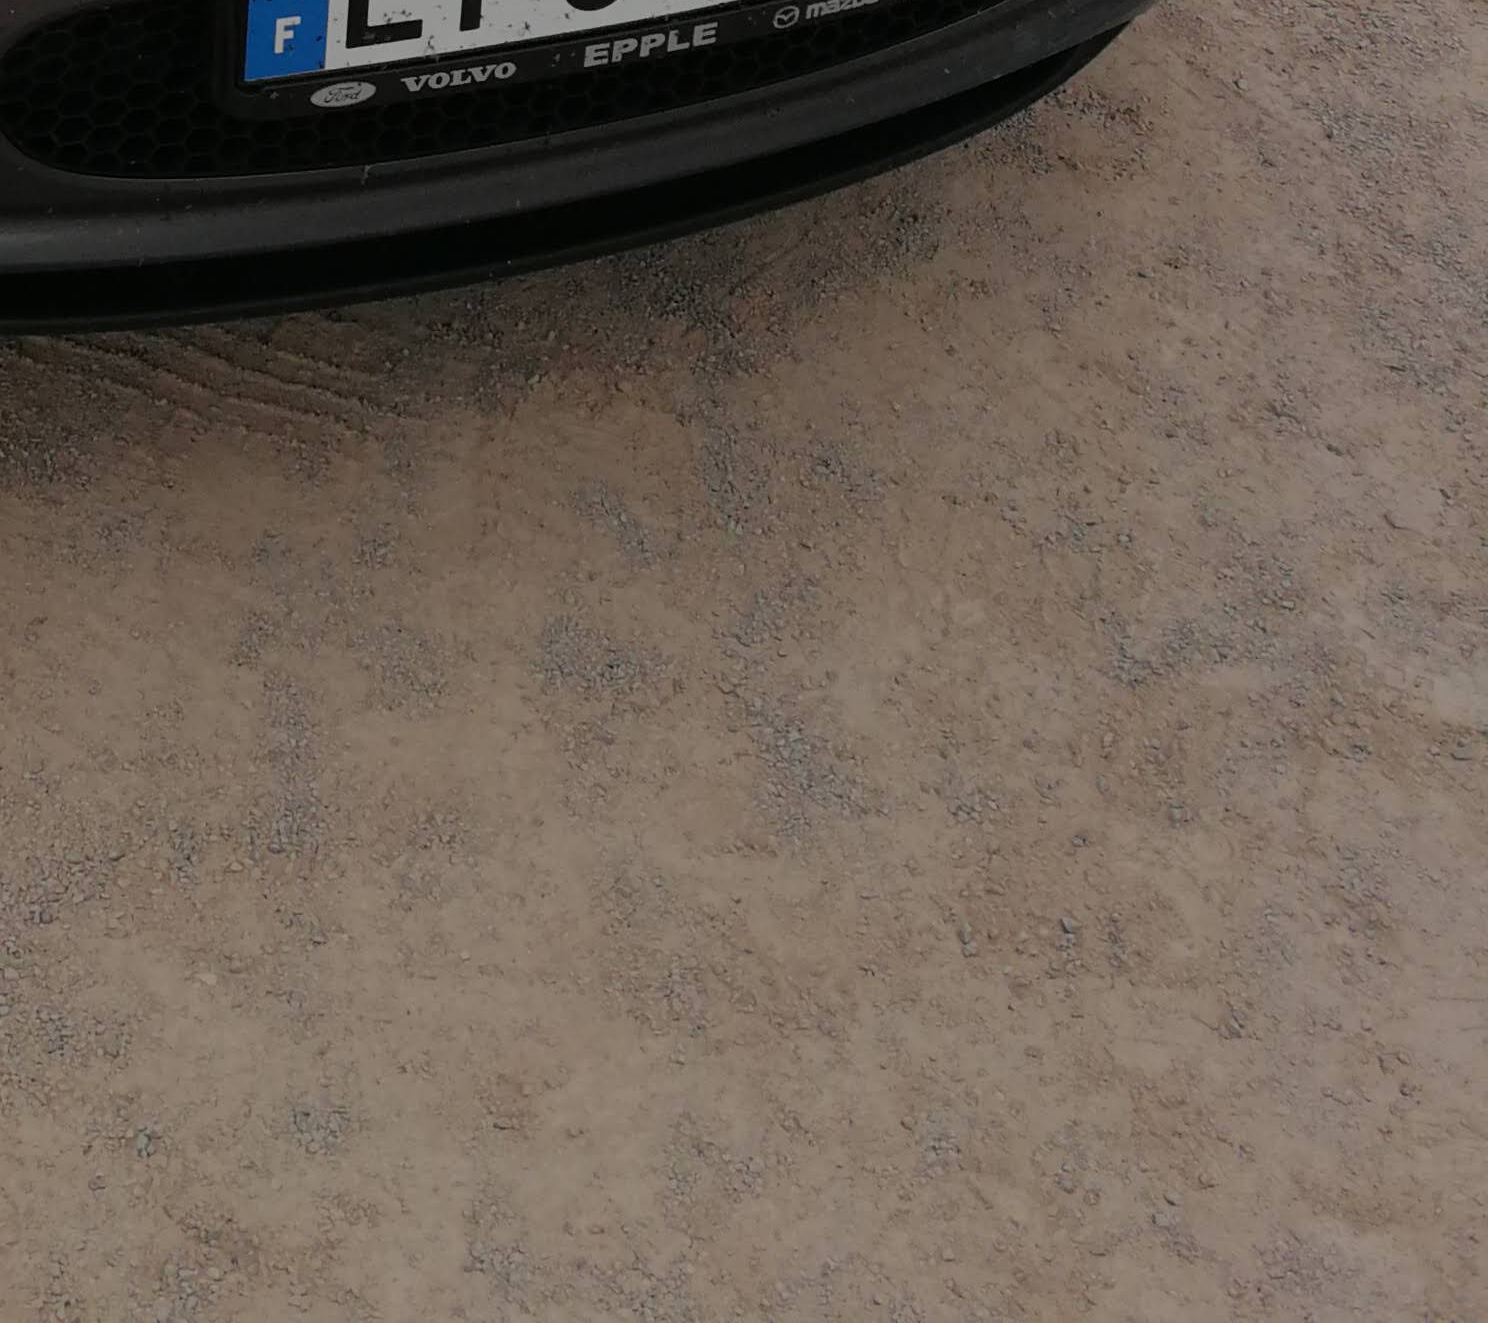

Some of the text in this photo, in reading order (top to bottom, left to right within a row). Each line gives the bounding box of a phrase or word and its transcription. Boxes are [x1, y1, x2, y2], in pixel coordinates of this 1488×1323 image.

[273, 15, 302, 55] F
[323, 82, 364, 104] Ford
[400, 61, 517, 93] VOLVO
[583, 22, 720, 68] EPPLE
